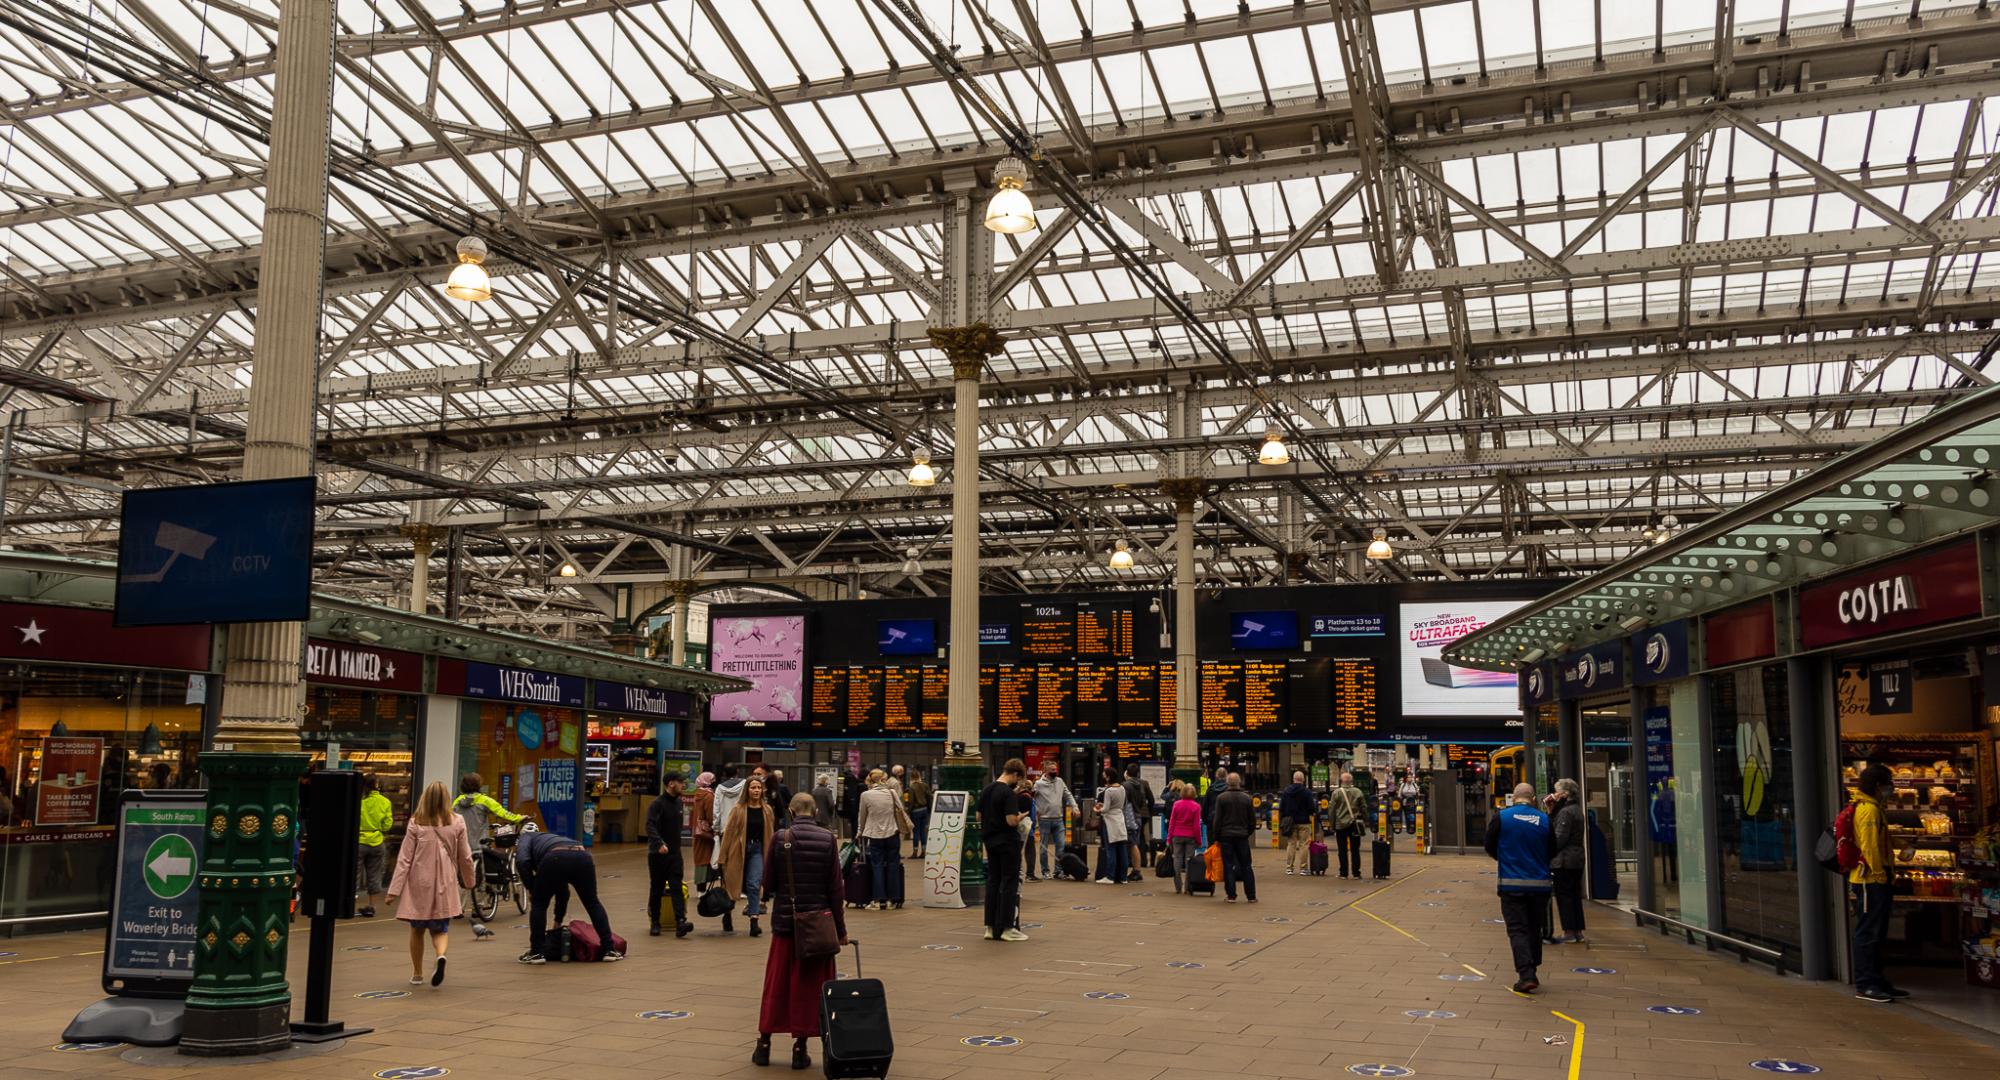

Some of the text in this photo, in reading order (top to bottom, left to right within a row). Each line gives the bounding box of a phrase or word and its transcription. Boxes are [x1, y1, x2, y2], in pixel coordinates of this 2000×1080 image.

[232, 555, 271, 572] CCTV
[1839, 576, 1909, 624] COSTA
[1414, 616, 1477, 634] SKY BROADBAND
[307, 645, 381, 682] RET A MANGER
[722, 660, 797, 672] PRETTYLITTLETHING
[498, 669, 561, 703] WHSmith
[1895, 672, 1900, 693] 2
[624, 686, 668, 714] WHSmith
[538, 767, 575, 782] IT TASTES
[537, 781, 574, 803] MAGIC
[152, 812, 196, 824] South Ramp
[24, 832, 104, 843] CAKES AMERICANO
[148, 905, 183, 920] Exit to
[123, 920, 199, 939] Waverley Bridg
